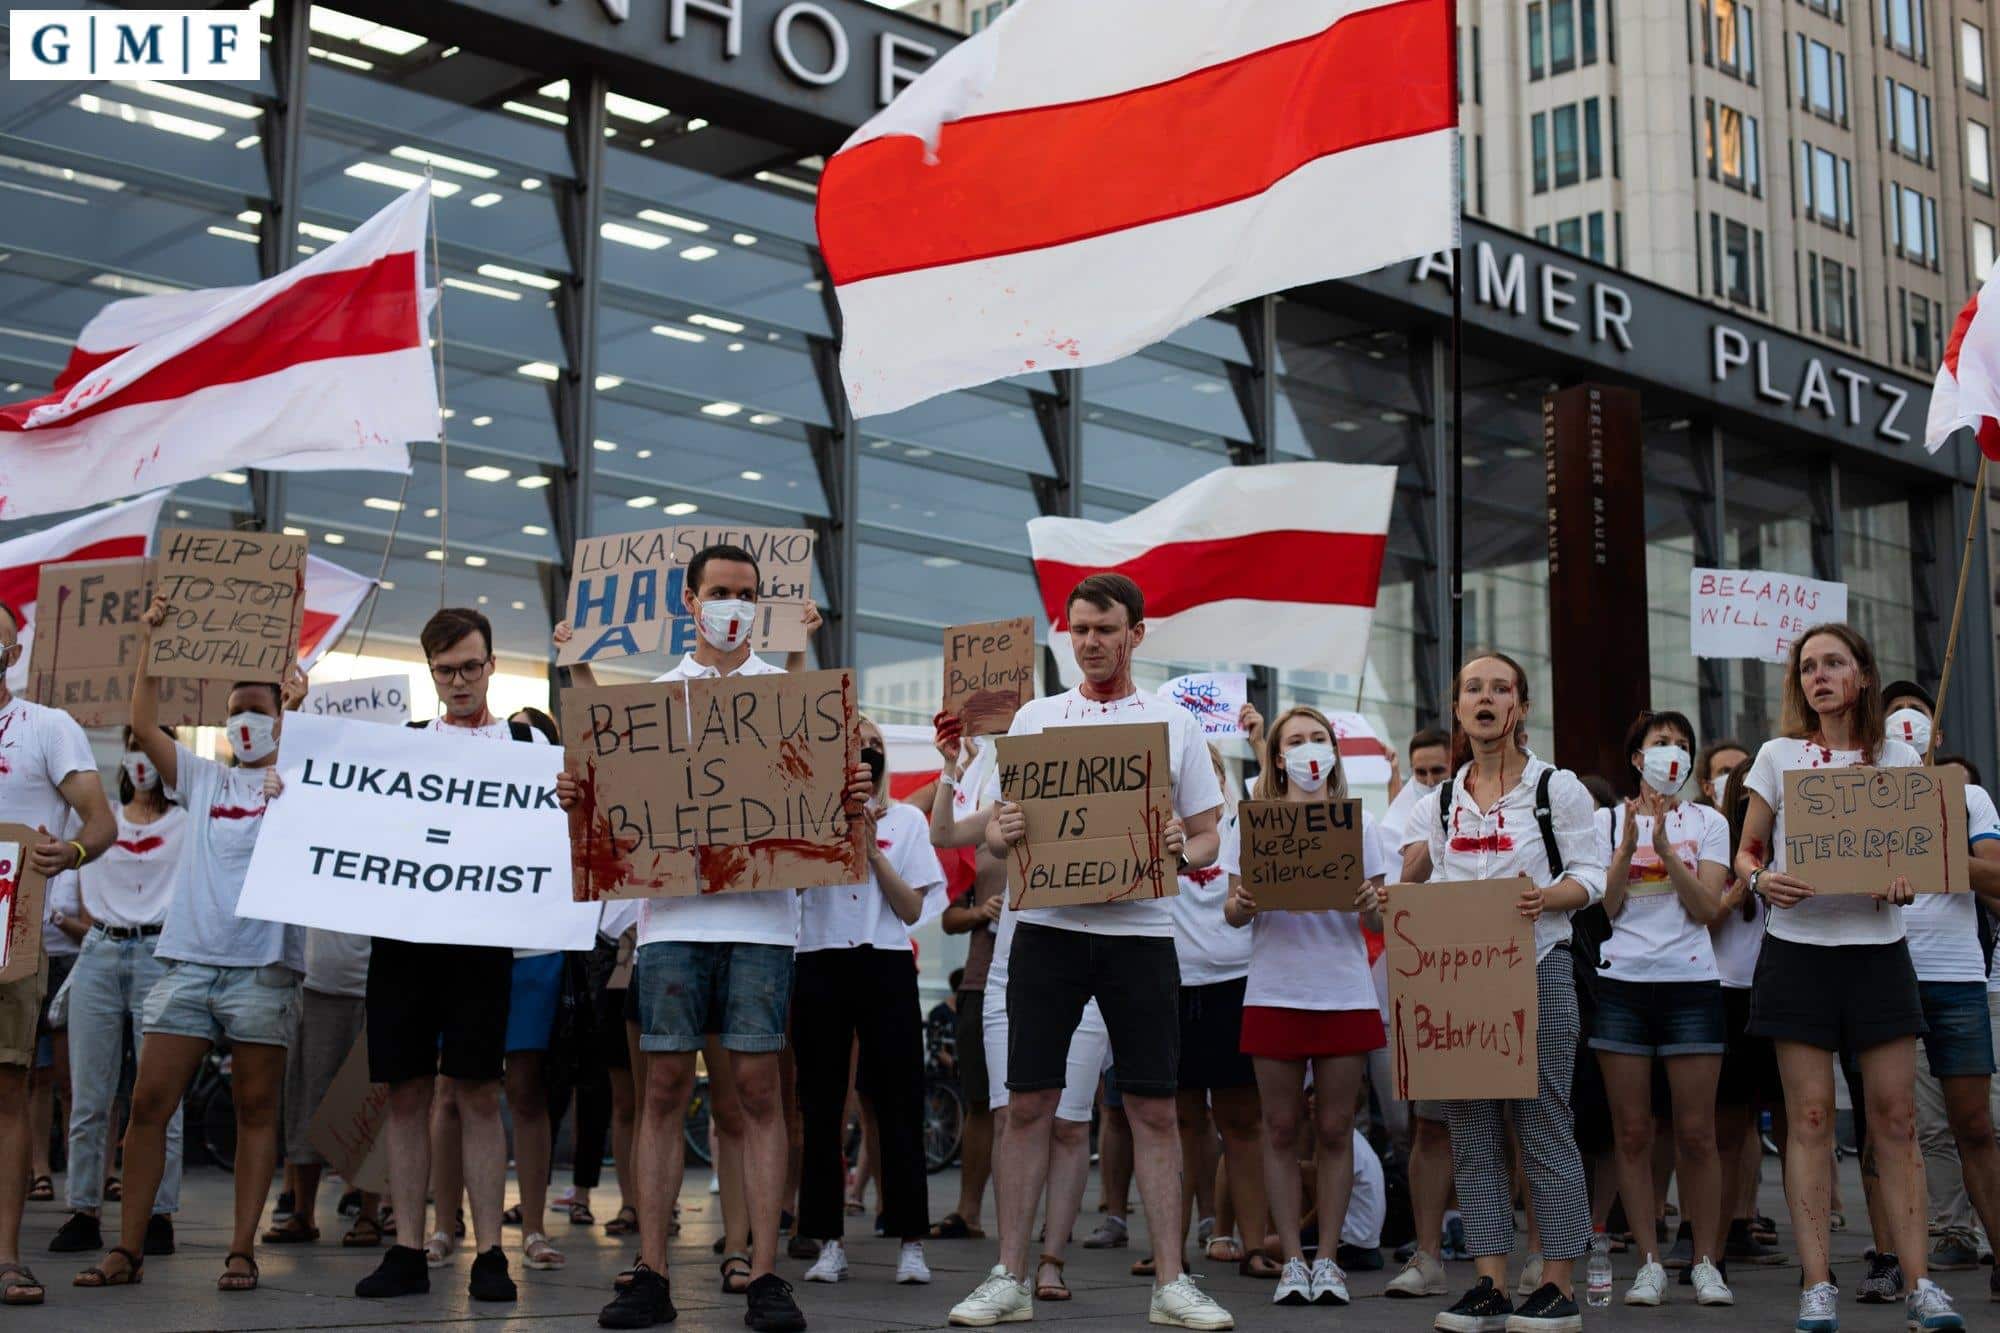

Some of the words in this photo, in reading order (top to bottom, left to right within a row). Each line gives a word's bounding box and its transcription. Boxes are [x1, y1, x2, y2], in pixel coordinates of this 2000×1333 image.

[602, 0, 938, 106] HOF
[1714, 324, 1911, 441] PLATZ
[1544, 401, 1557, 496] BERLINER
[1589, 389, 1604, 484] BERLINER
[168, 533, 262, 565] HELP
[1549, 507, 1560, 574] MAUER
[1594, 496, 1606, 565] MAUER
[1699, 574, 1821, 611] BELARUS
[165, 604, 289, 640] POLICE
[1779, 613, 1804, 634] BE
[952, 631, 1014, 662] Free
[949, 660, 1032, 695] Belarus
[590, 689, 843, 757] BELARUS
[1000, 753, 1147, 801] #BELARUS
[1797, 771, 1933, 816] STOP
[1057, 806, 1089, 839] IS
[1247, 805, 1300, 838] WHY
[1306, 803, 1353, 832] EU
[1251, 834, 1323, 859] keeps
[1785, 825, 1933, 865] TERROR
[308, 845, 553, 895] TERRORIST
[1029, 857, 1165, 890] BLEEDING
[1251, 853, 1356, 885] silence?
[1393, 909, 1523, 983] Support
